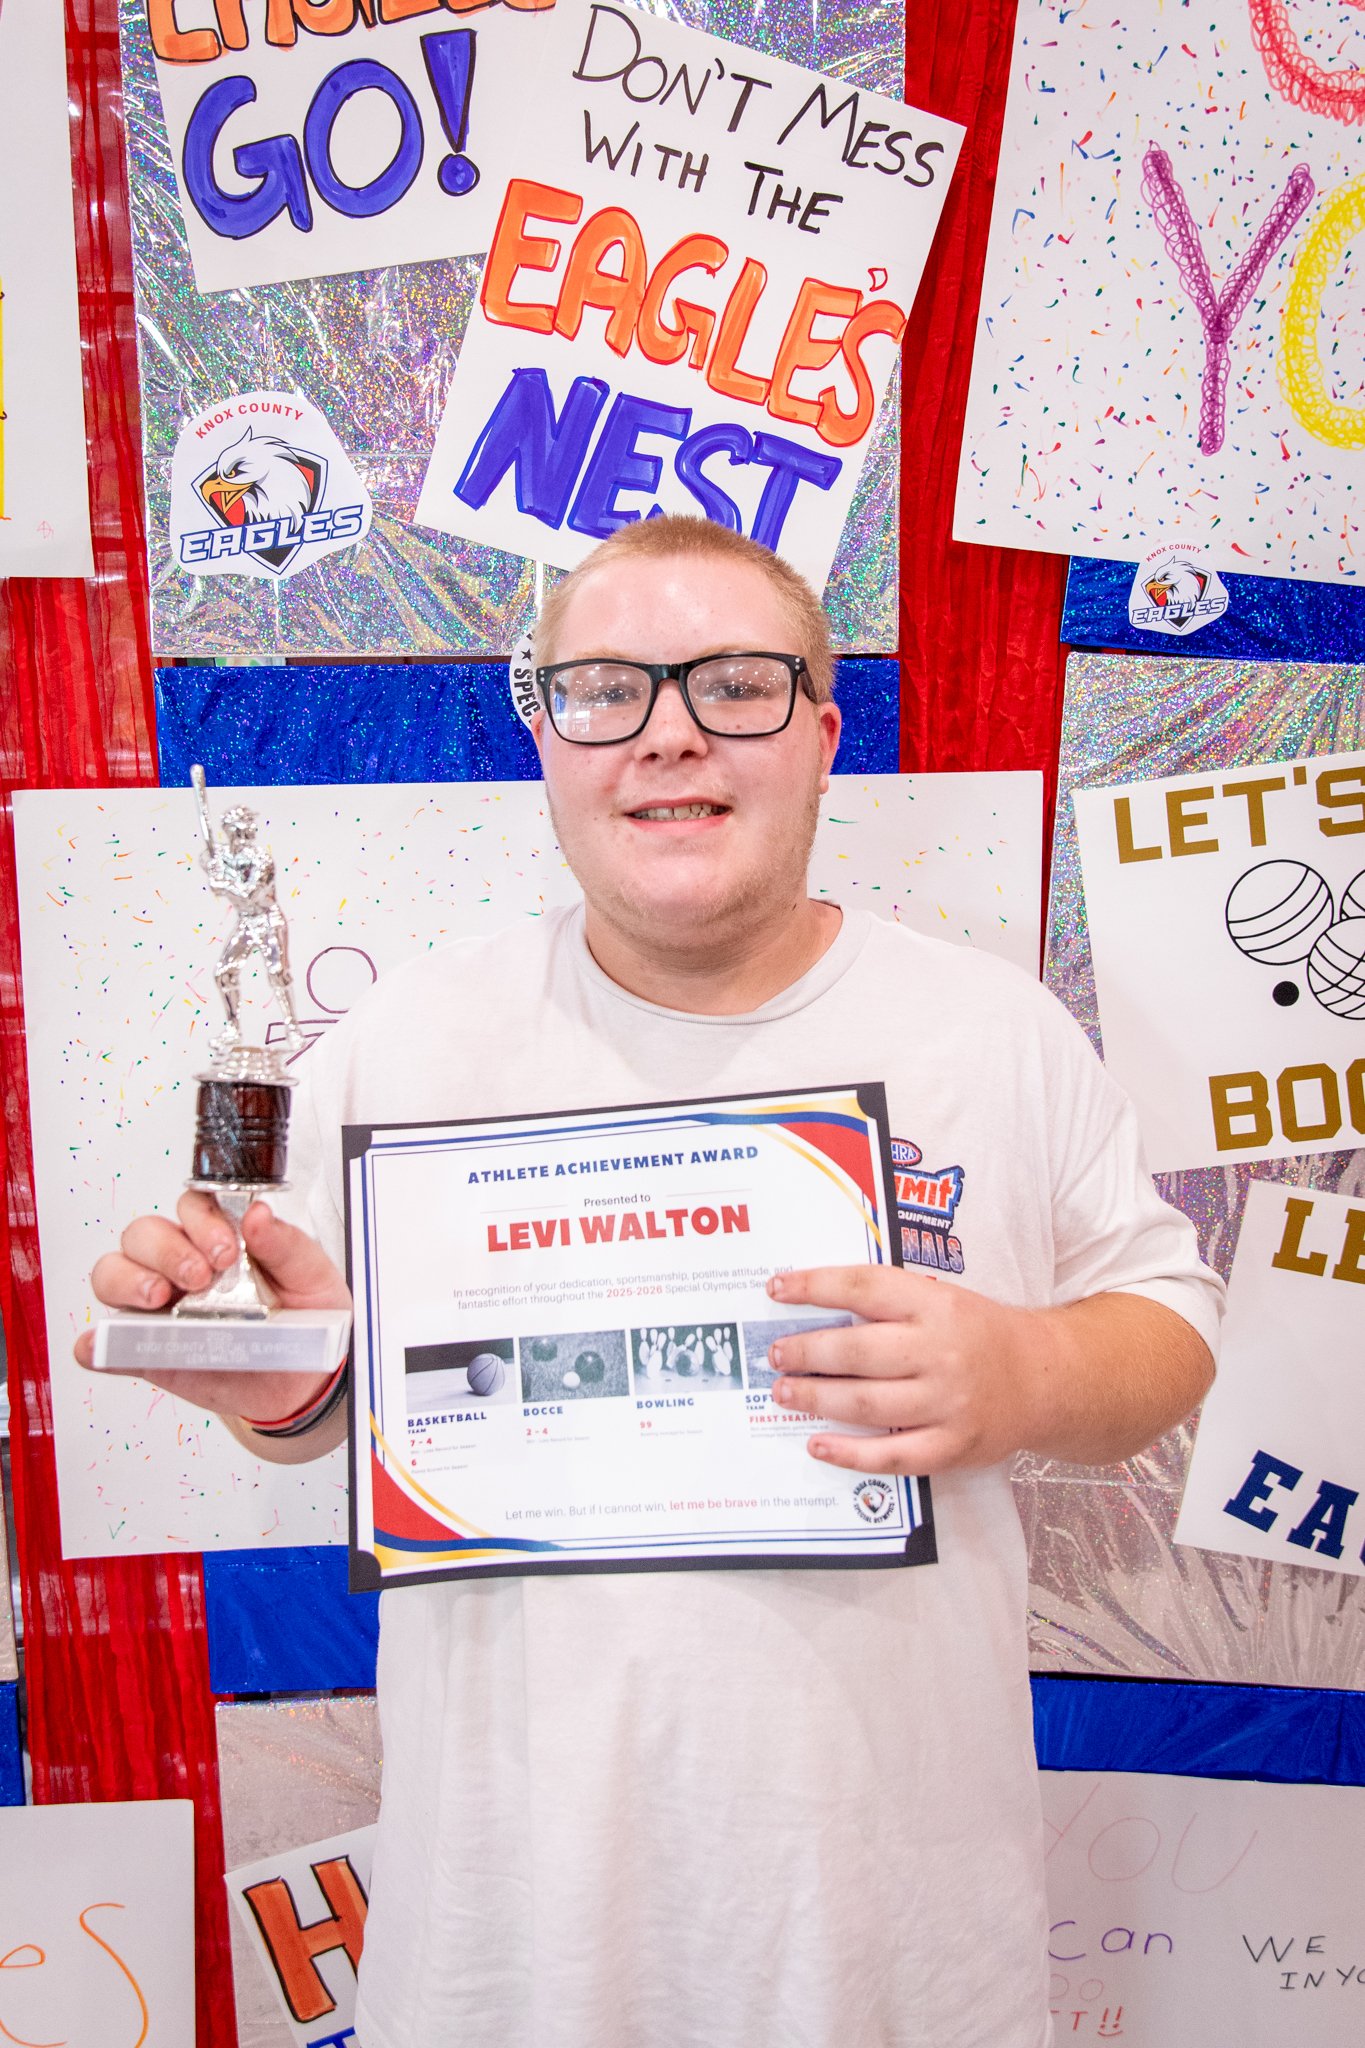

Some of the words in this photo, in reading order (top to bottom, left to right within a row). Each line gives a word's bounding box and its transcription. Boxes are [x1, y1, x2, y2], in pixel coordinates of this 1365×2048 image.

[572, 3, 772, 133] DON'T
[777, 83, 945, 188] MESS
[182, 28, 480, 240] GO!
[583, 110, 709, 193] WITH
[744, 161, 843, 234] THE
[195, 409, 234, 439] KNOX
[238, 403, 303, 421] COUNTY
[453, 368, 842, 552] NEST
[180, 504, 364, 563] EAGLES
[1146, 547, 1167, 562] KNOX
[1169, 544, 1202, 554] COUNTY
[1131, 597, 1227, 625] EAGLES
[514, 668, 541, 724] SPEC
[1113, 766, 1365, 864] LET'S
[468, 1165, 549, 1184] ATHLETE
[555, 1153, 685, 1176] ACHIEVEMENT
[690, 1146, 758, 1165] AWARD
[891, 1143, 916, 1161] HRA
[584, 1193, 638, 1207] Presented
[640, 1194, 651, 1203] to
[487, 1218, 571, 1252] LEVI
[579, 1204, 751, 1244] WALTON
[898, 1210, 952, 1230] QUIPMENT
[901, 1227, 964, 1272] NALS
[457, 1296, 500, 1310] fantastic
[502, 1294, 528, 1306] effort
[530, 1291, 585, 1305] throughout
[587, 1289, 604, 1299] the
[665, 1283, 701, 1295] Special
[703, 1280, 747, 1293] Olympics
[465, 1283, 522, 1298] recognition
[524, 1282, 533, 1291] of
[535, 1282, 557, 1293] your
[559, 1277, 614, 1290] dedication,
[692, 1268, 730, 1281] positive
[523, 1406, 563, 1417] BOCCE
[636, 1398, 695, 1409] BOWLING
[745, 1394, 775, 1403] SOFT
[407, 1411, 487, 1427] BASKETBALL
[749, 1414, 779, 1423] FIRST
[505, 1510, 522, 1520] Let
[525, 1509, 541, 1519] me
[569, 1505, 586, 1516] But
[589, 1504, 596, 1515] if
[604, 1504, 641, 1515] cannot
[670, 1500, 684, 1510] let
[688, 1501, 705, 1510] me
[708, 1499, 721, 1509] be
[725, 1498, 758, 1508] brave
[761, 1496, 770, 1507] in
[773, 1496, 790, 1506] the
[1222, 1449, 1365, 1567] EA
[1242, 1934, 1326, 1963] WE
[1280, 1970, 1325, 1989] IN
